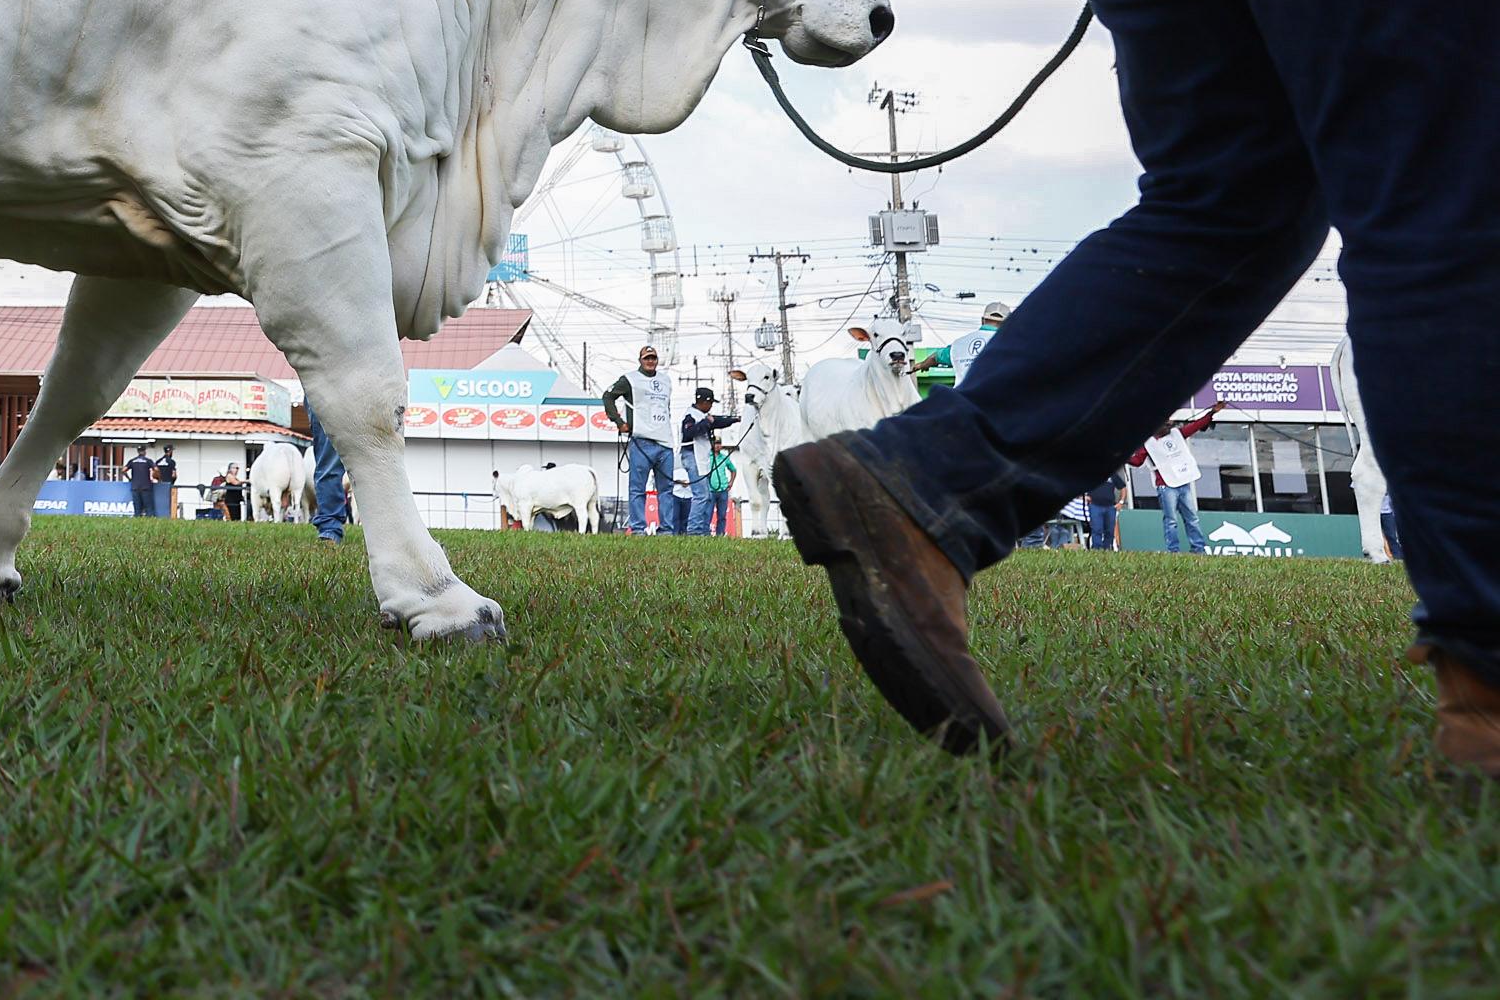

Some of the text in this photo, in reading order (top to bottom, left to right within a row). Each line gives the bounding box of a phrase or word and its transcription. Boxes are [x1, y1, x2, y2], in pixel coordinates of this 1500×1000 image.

[1212, 372, 1298, 382] PISTA PRINCIPAL
[456, 379, 533, 397] SICOOB
[1213, 380, 1299, 393] COORDENAÇÃO
[153, 388, 184, 404] BATATA
[198, 389, 227, 404] BATATA
[1217, 392, 1298, 402] E JULGAMENTO
[84, 500, 135, 512] PARANÁ
